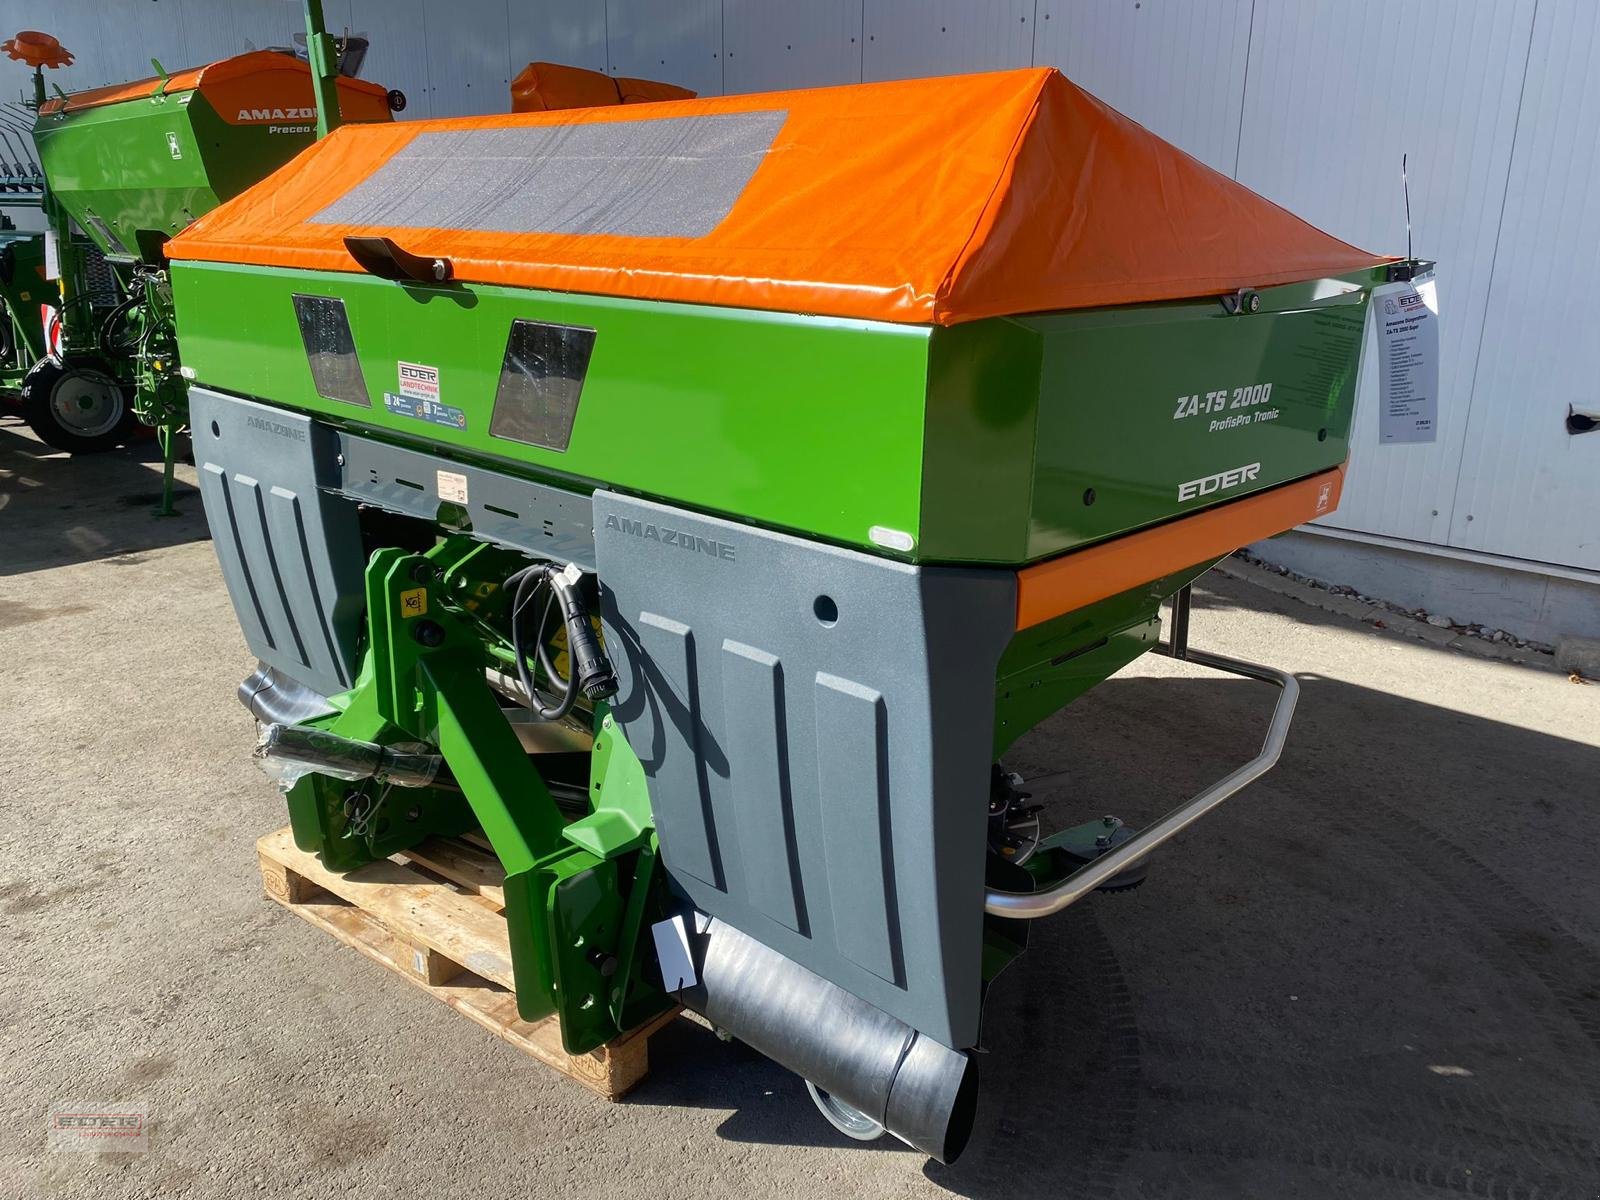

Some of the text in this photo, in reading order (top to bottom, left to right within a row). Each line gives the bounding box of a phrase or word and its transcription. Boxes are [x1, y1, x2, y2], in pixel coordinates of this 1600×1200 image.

[400, 379, 438, 393] LANDTECHNIK
[401, 367, 436, 381] EDER
[393, 396, 400, 406] 24
[432, 404, 437, 414] 7
[1173, 383, 1273, 420] ZA-TS 2000
[247, 415, 306, 442] AMAZONE
[1209, 408, 1280, 432] ProfisPro Tronic
[1178, 462, 1261, 502] EDER
[605, 513, 736, 562] AMAZONE
